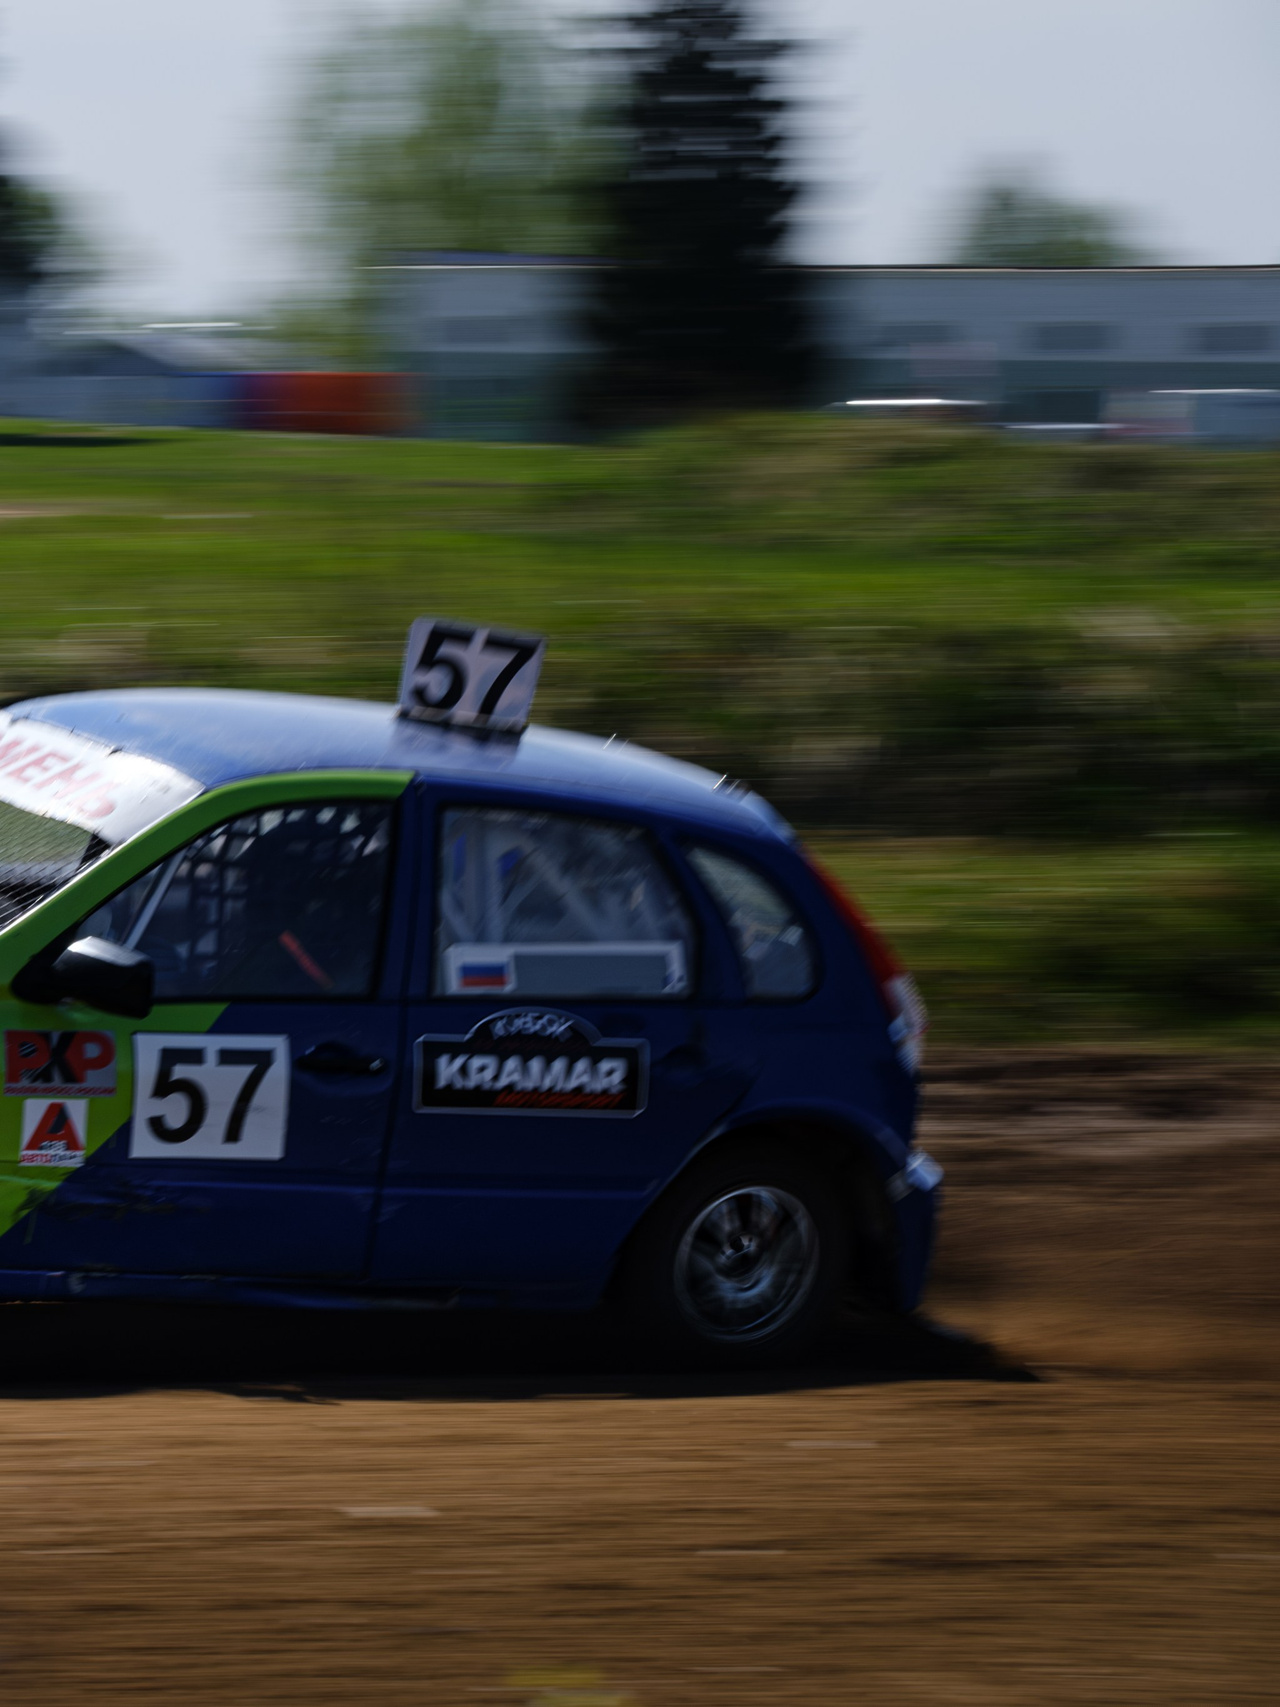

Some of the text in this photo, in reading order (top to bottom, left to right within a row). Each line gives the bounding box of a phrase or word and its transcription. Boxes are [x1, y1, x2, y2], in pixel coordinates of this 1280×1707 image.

[411, 620, 543, 722] 57
[145, 1046, 277, 1145] 57
[434, 1054, 629, 1094] KRAMAR
